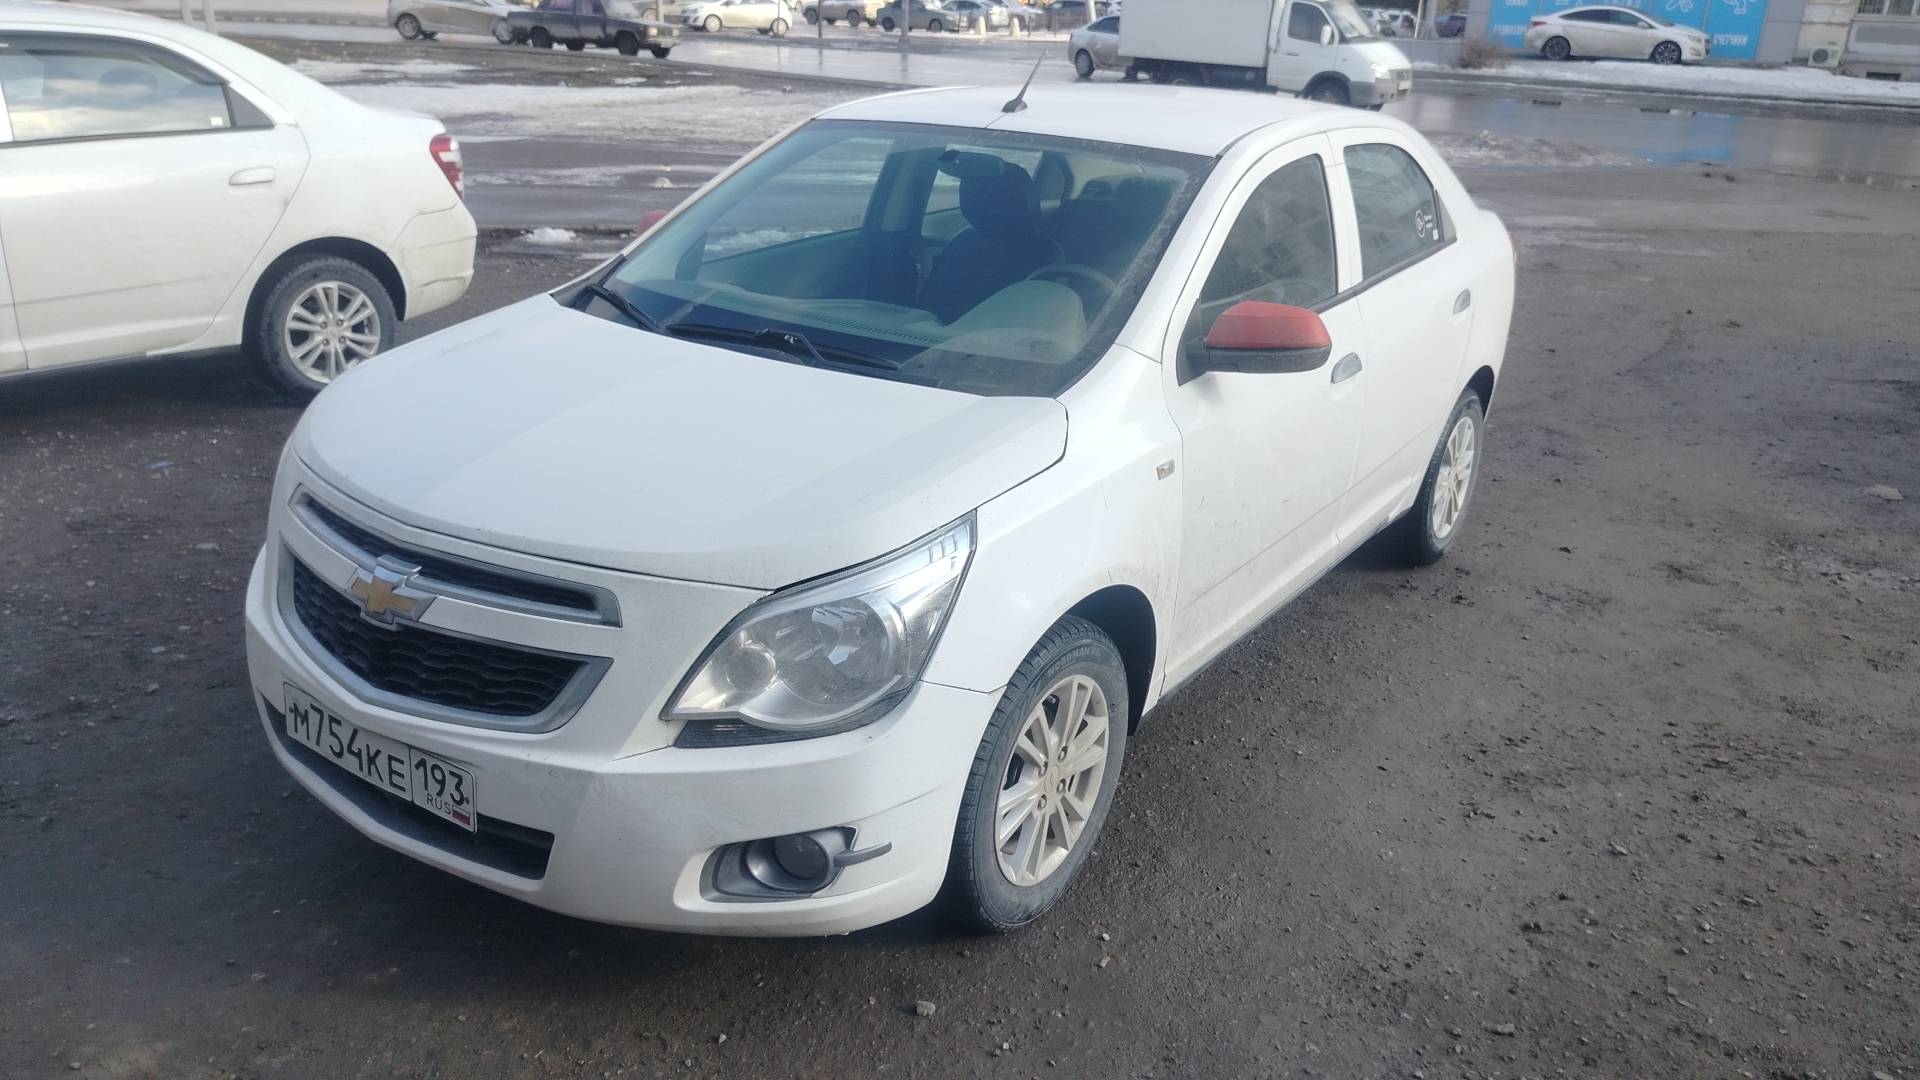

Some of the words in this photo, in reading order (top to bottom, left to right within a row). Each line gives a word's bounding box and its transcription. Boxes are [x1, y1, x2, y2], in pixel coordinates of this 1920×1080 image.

[292, 702, 406, 792] М754КЕ
[414, 757, 464, 806] 193
[426, 793, 451, 815] RUS
